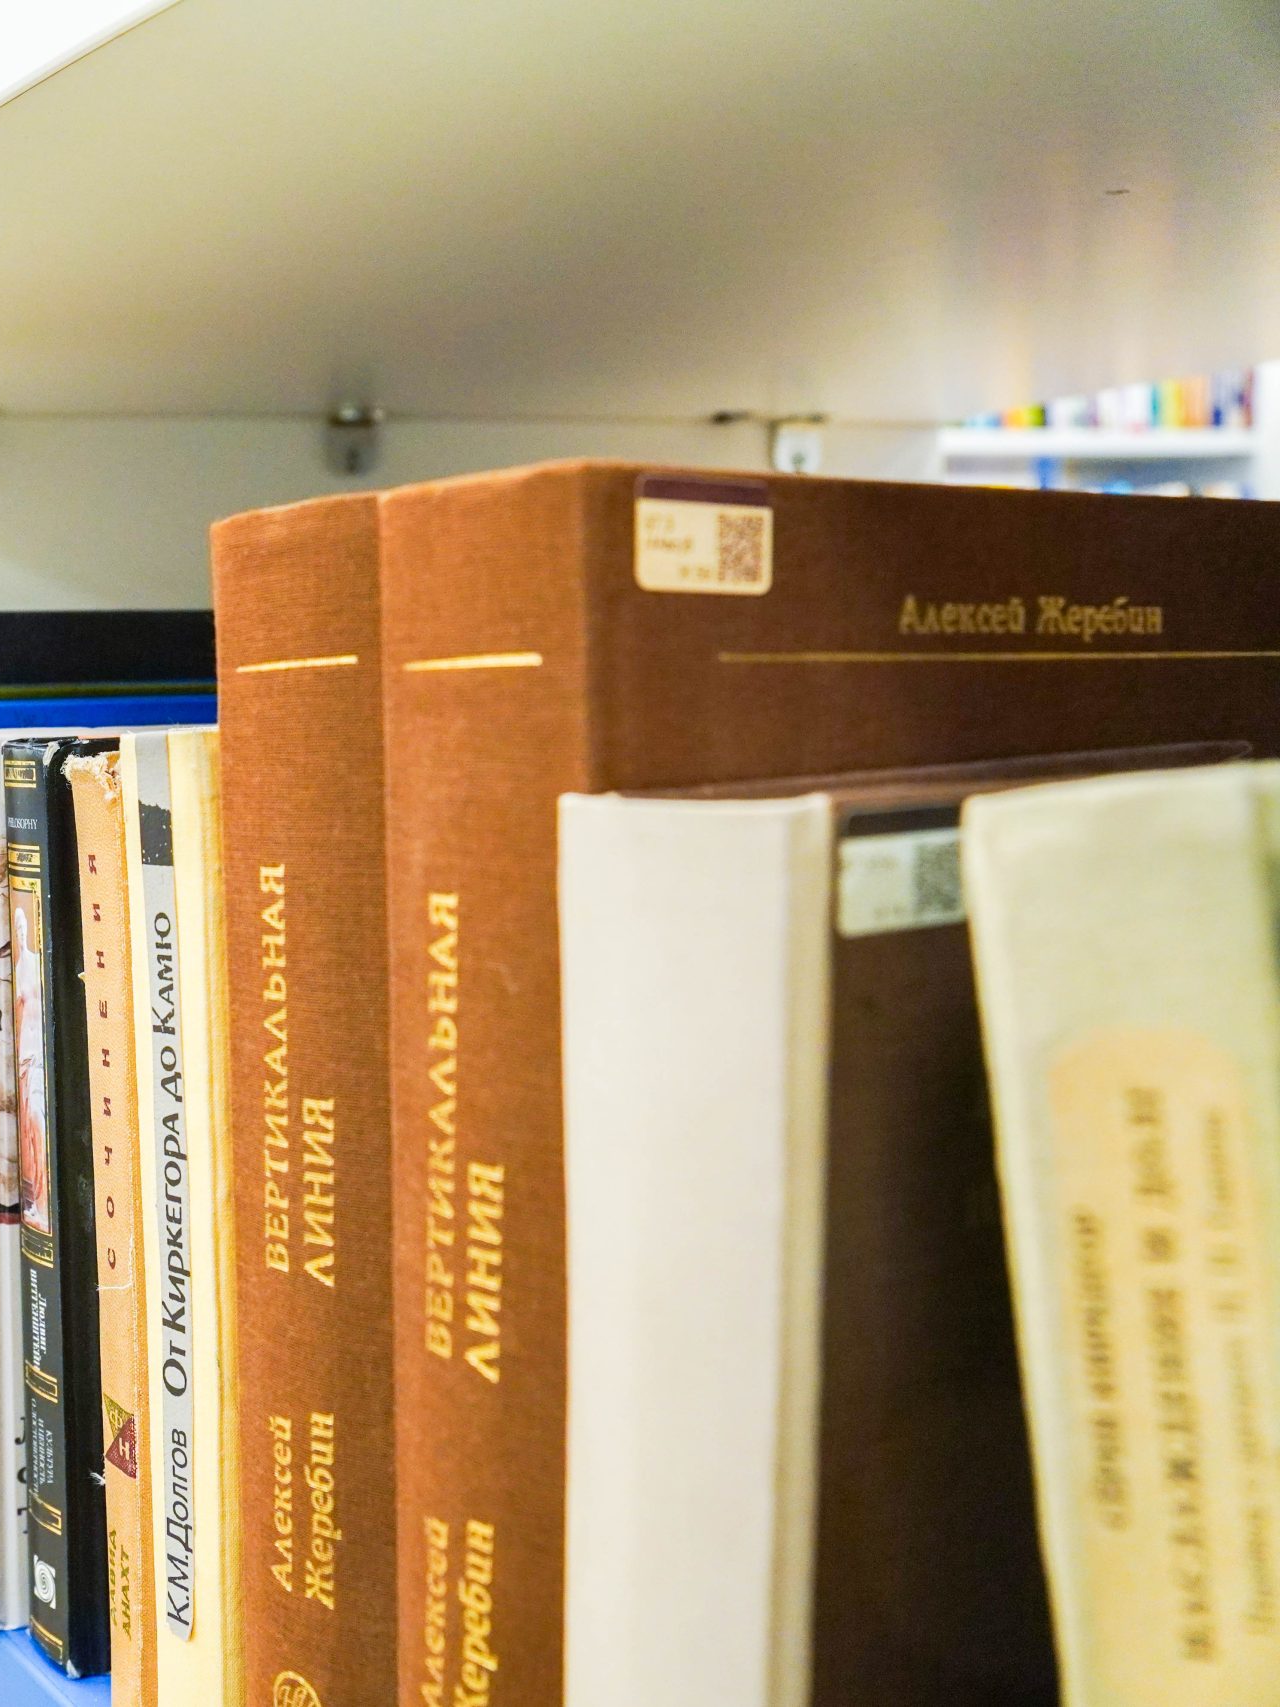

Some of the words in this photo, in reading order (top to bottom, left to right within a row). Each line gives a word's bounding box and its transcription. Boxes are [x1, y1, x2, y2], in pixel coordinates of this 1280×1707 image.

[898, 594, 1025, 633] Алексей
[1035, 596, 1162, 642] Жеребин
[259, 863, 290, 1273] ВЕРТИКАЛЬНАЯ
[424, 891, 459, 1360] ВЕРТИКАЛЬНАЯ
[302, 1097, 335, 1288] ЛИНИЯ
[464, 1162, 505, 1384] ЛИНИЯ
[120, 1544, 132, 1642] АНАХТ
[269, 1414, 293, 1593] Алексей
[304, 1411, 342, 1611] Жеребин
